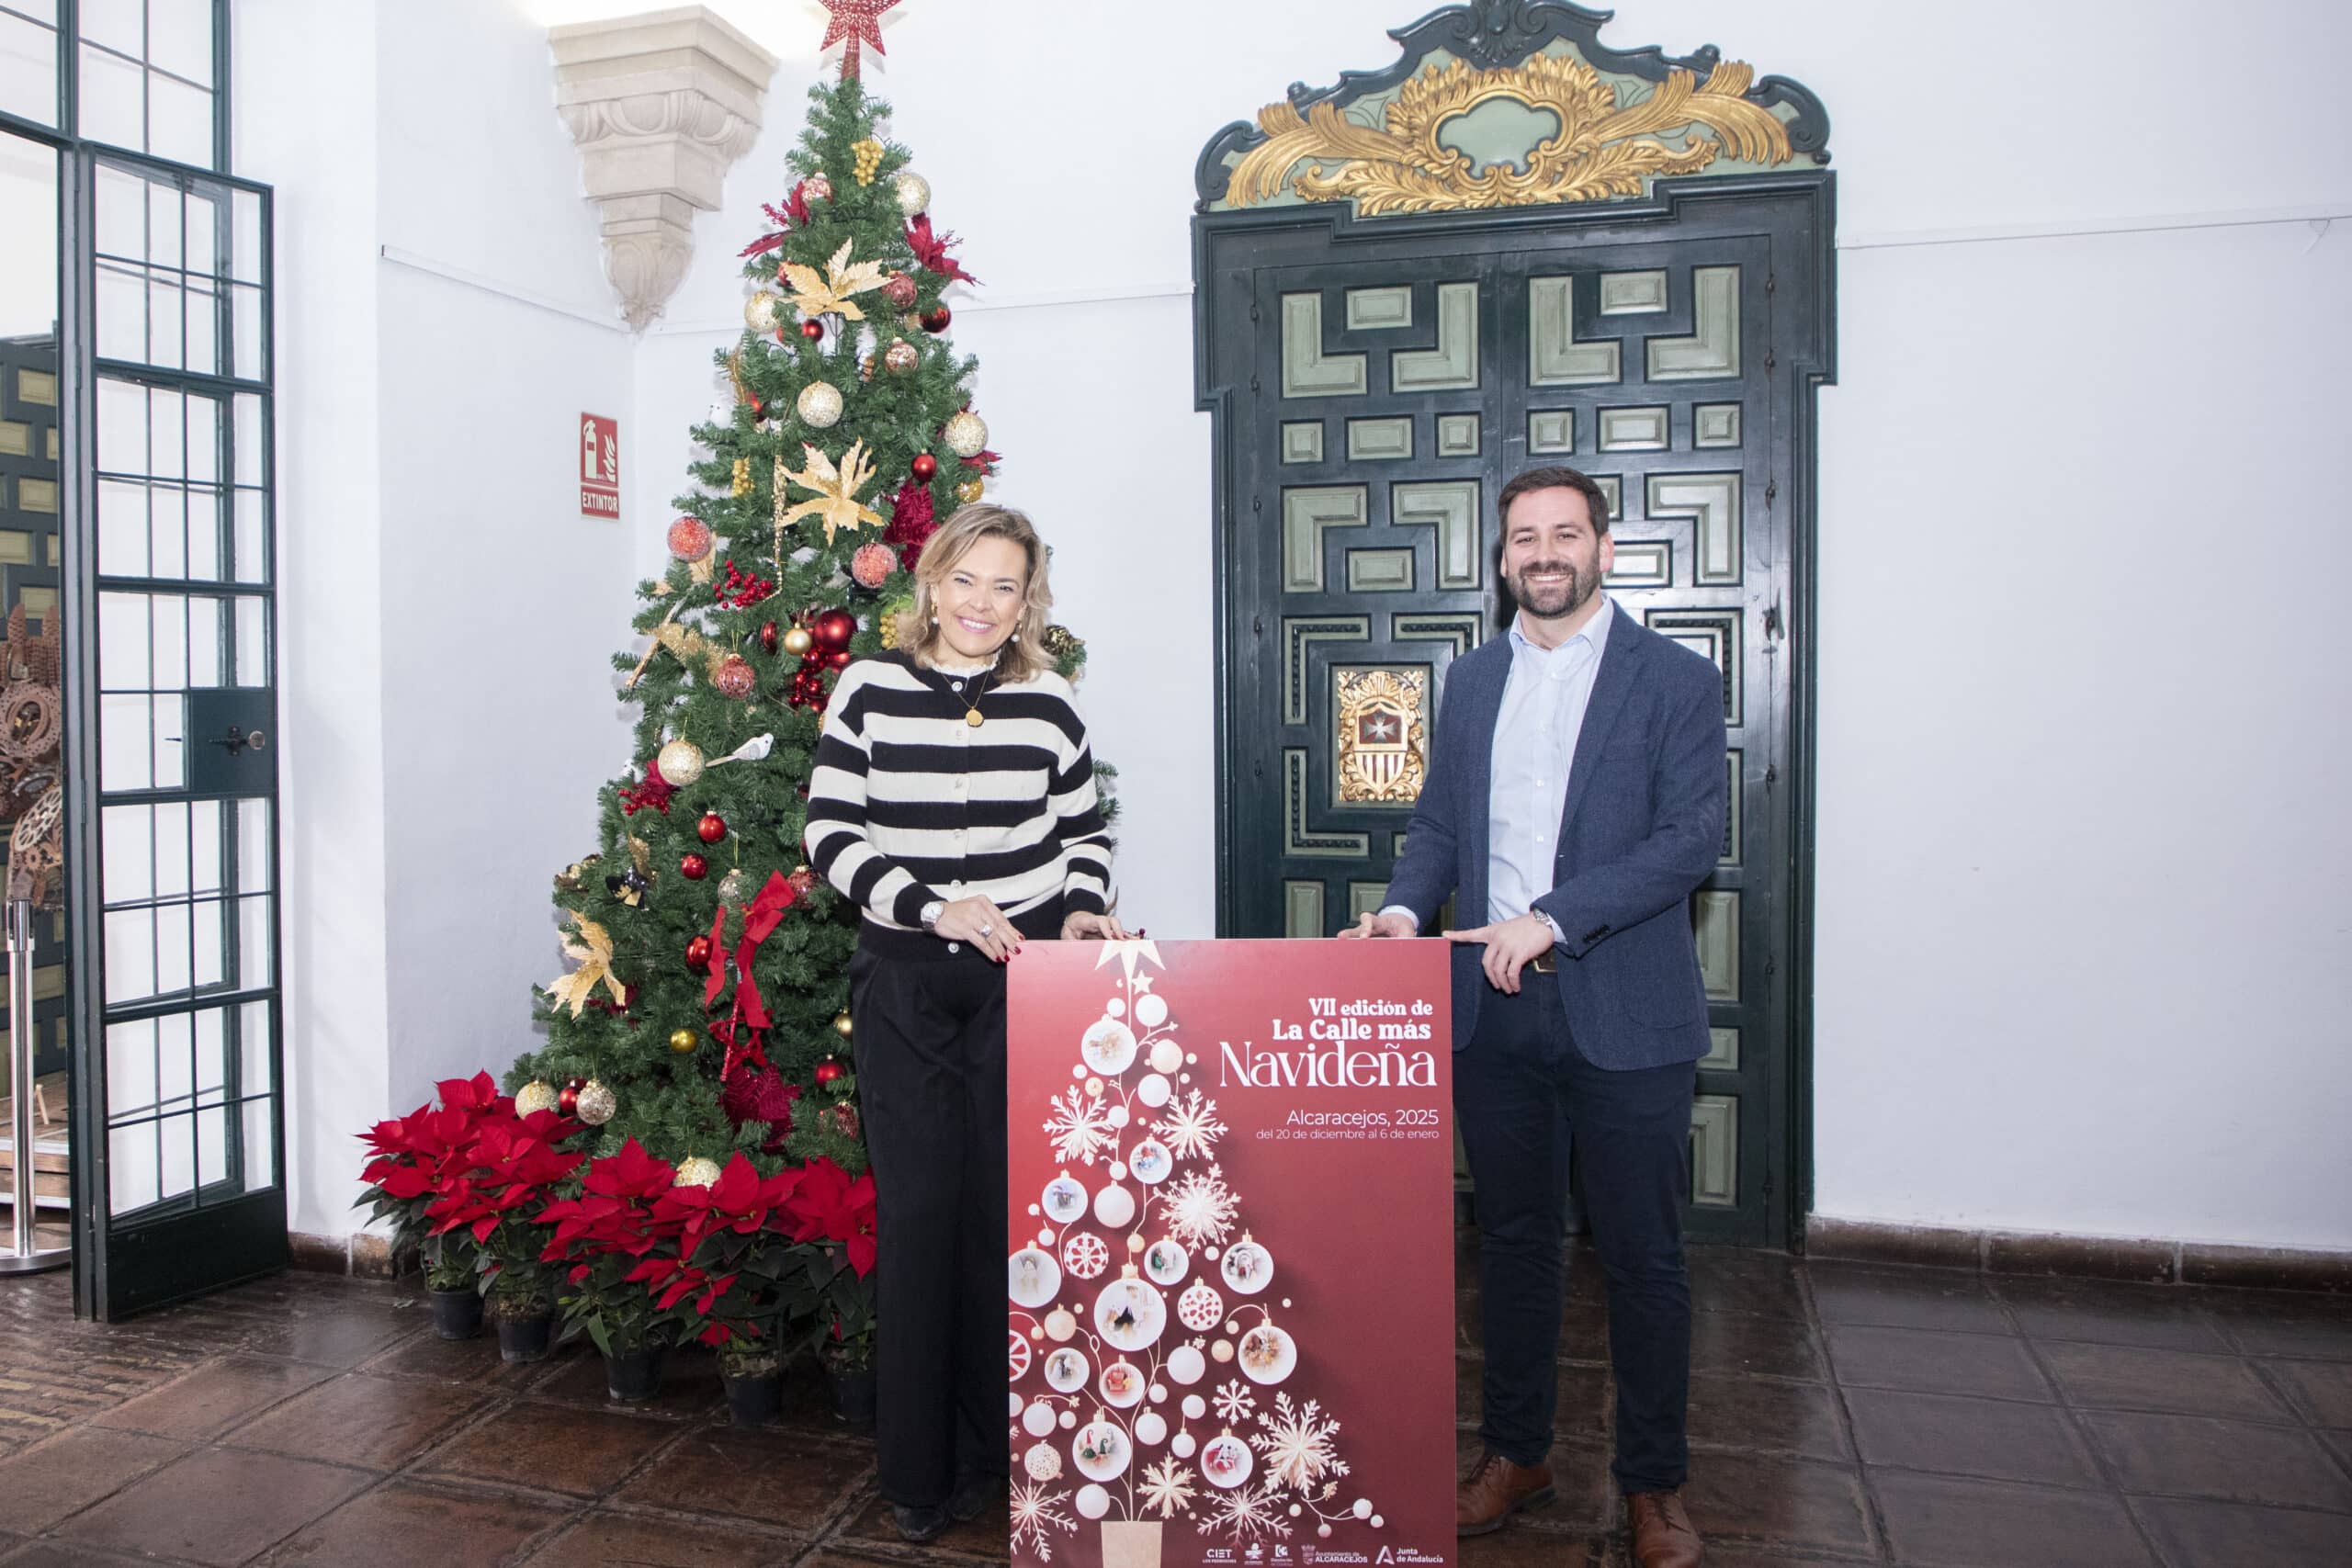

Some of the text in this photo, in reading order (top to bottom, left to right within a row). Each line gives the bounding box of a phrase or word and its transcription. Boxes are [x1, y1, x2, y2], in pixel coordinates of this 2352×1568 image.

[582, 491, 617, 512] EXTINTOR
[1308, 998, 1433, 1016] VII edición de
[1272, 1018, 1431, 1040] La Calle más
[1219, 1040, 1437, 1087] Navideña
[1286, 1109, 1439, 1128] Alcaracejos, 2025
[1256, 1128, 1440, 1139] del 20 de diciembre al 6 de enero
[1206, 1549, 1233, 1558] CIET
